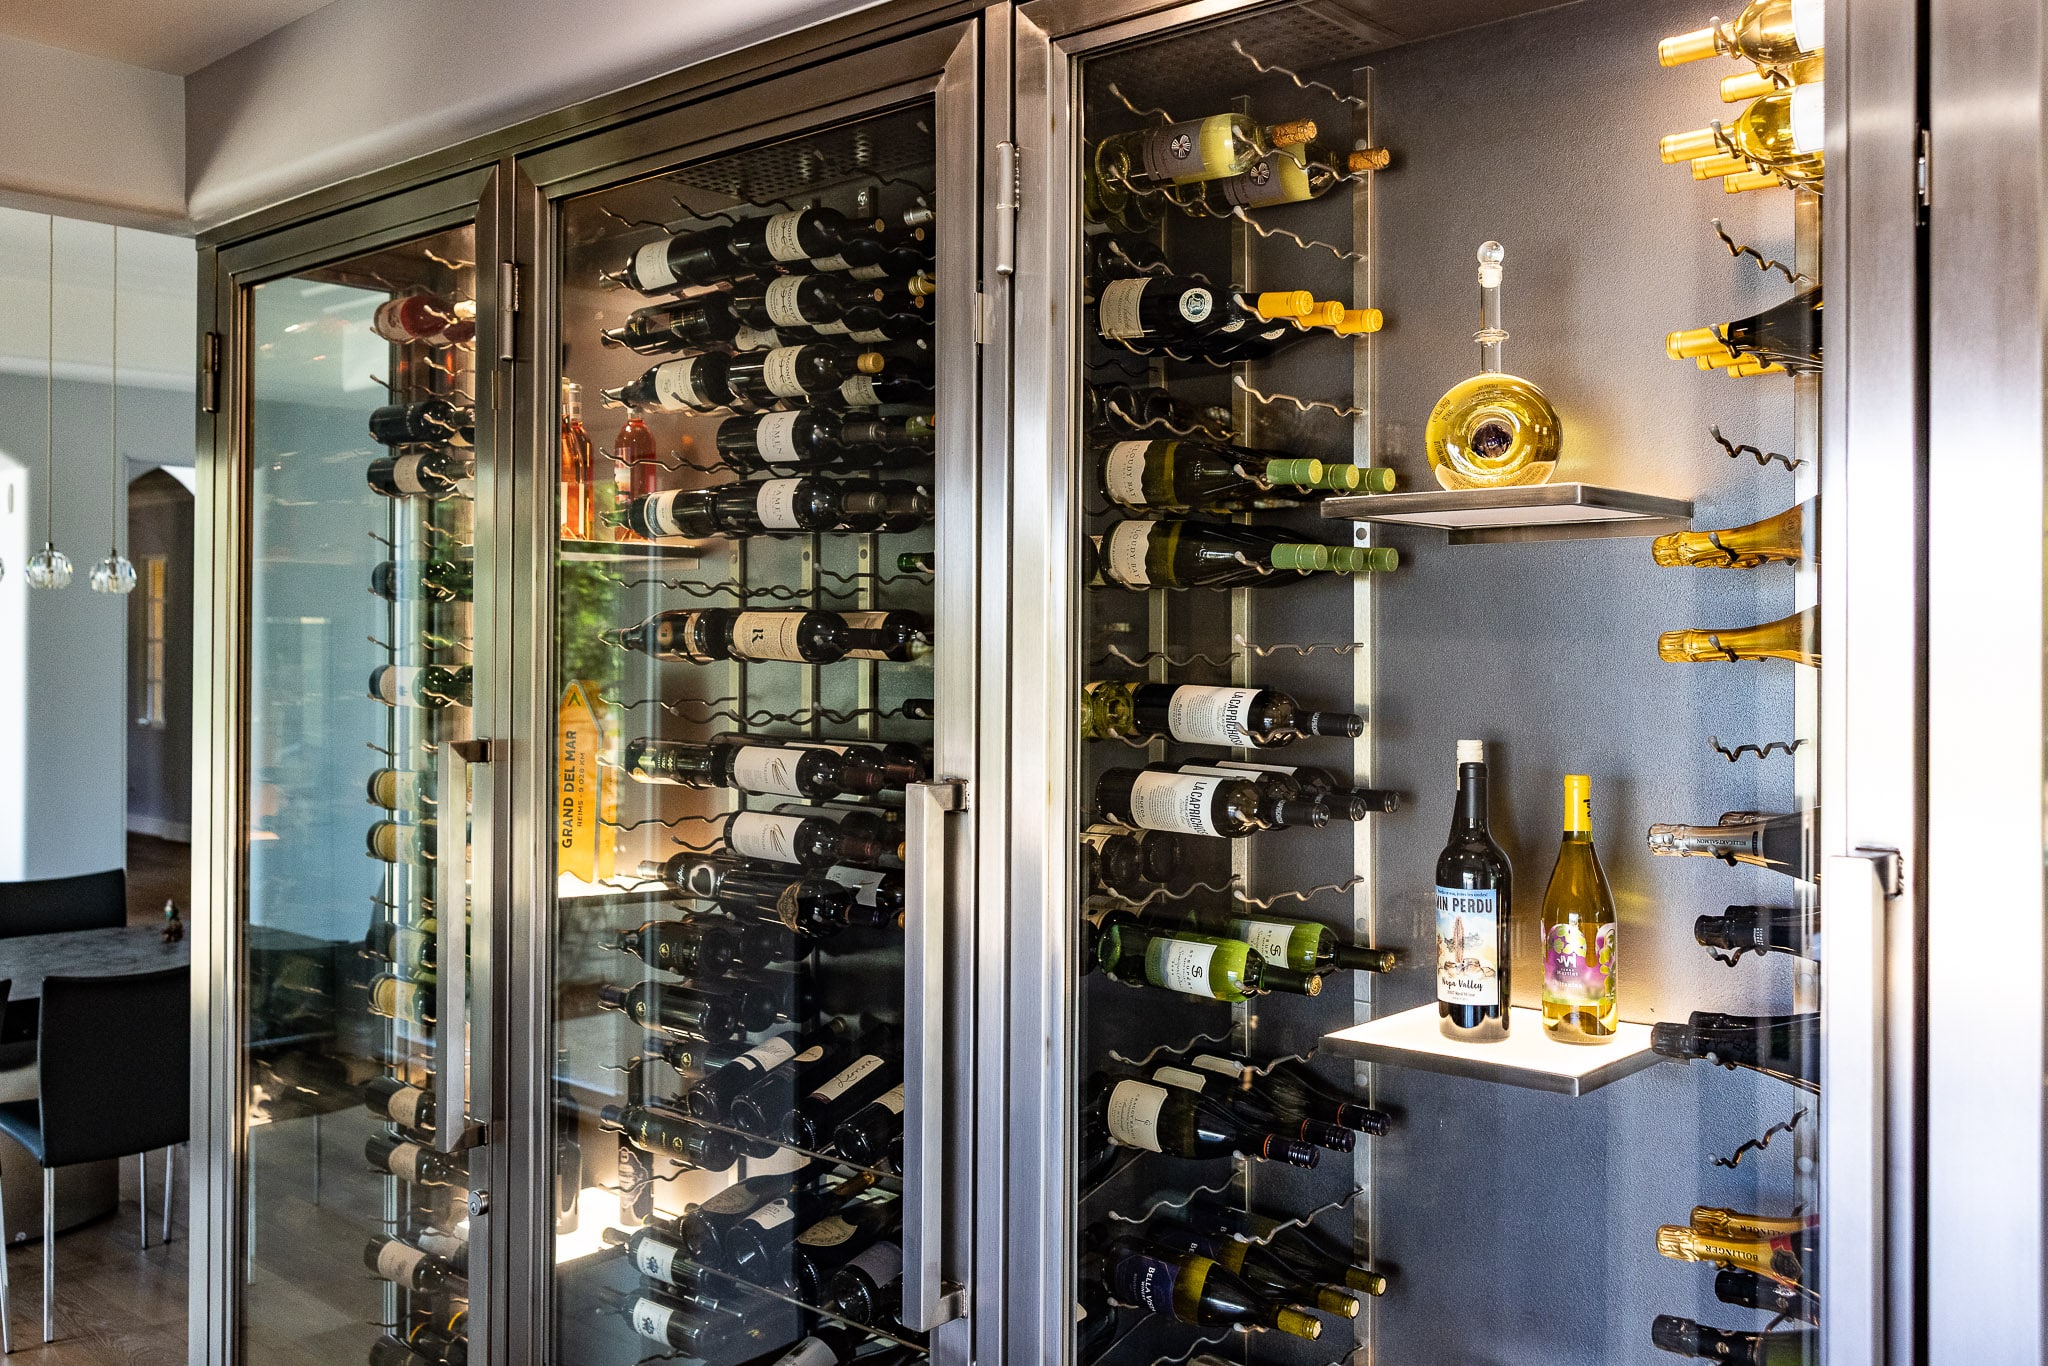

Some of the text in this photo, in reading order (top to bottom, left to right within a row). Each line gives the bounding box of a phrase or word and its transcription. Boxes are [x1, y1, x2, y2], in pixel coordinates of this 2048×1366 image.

[1130, 524, 1144, 559] CLOUDY
[562, 730, 576, 849] GRAND DEL MAR
[1452, 897, 1493, 914] PERDU
[1441, 976, 1484, 991] Napa Valley
[1705, 1245, 1759, 1262] BOLLINGER
[1144, 1267, 1156, 1293] BELLA
